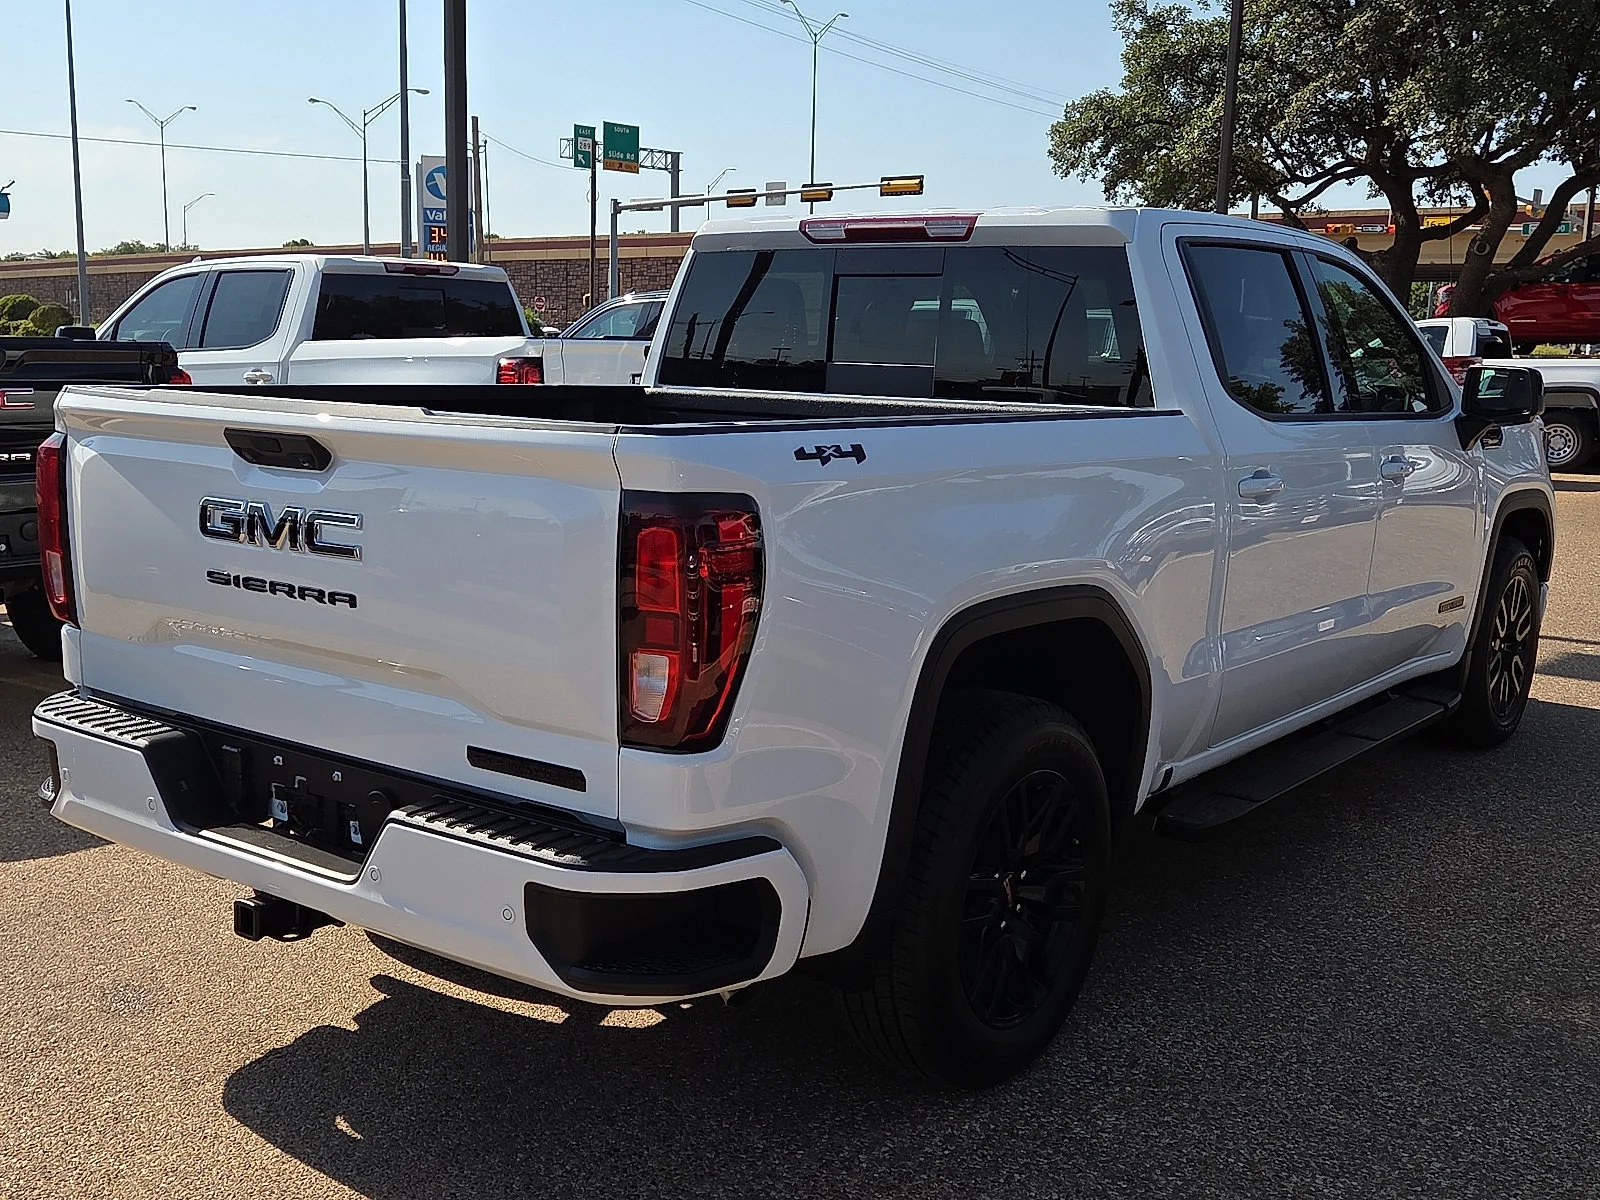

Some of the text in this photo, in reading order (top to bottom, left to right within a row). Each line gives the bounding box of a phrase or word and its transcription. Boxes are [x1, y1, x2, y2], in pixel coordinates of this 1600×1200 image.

[579, 128, 591, 136] EAST
[614, 126, 630, 134] SOUTH
[580, 141, 591, 150] 289
[608, 150, 635, 160] Slide Rd
[426, 209, 447, 221] Val
[200, 496, 363, 562] GMC
[206, 569, 357, 608] SIERRA
